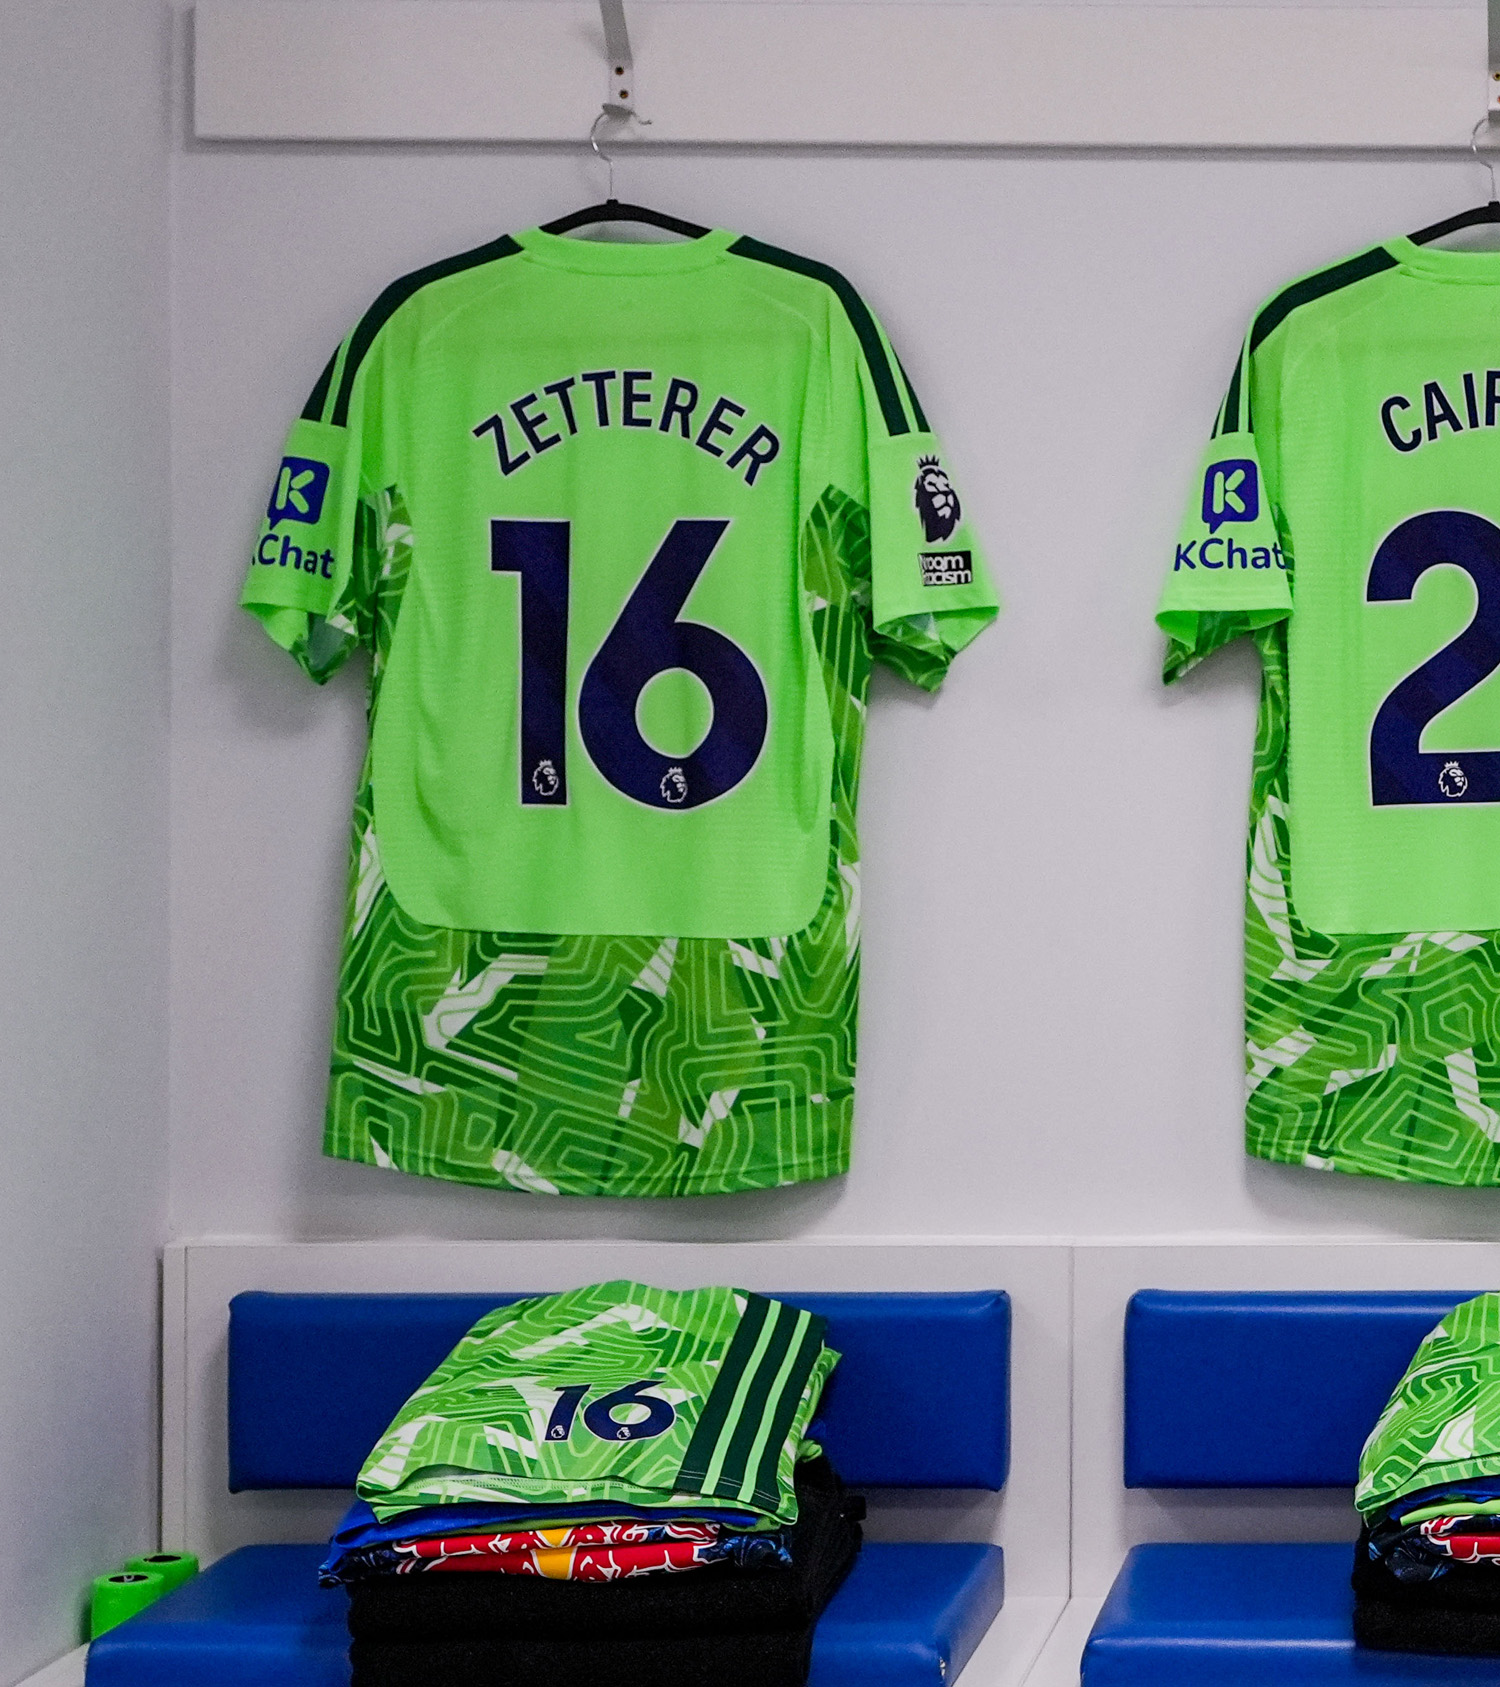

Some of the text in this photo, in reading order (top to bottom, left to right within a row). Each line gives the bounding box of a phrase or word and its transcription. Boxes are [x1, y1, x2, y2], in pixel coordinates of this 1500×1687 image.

[472, 370, 780, 487] ZETTERER
[275, 466, 315, 514] K
[1212, 469, 1246, 515] K
[251, 533, 335, 579] Chat
[1173, 537, 1287, 571] KChat
[490, 519, 768, 811] 16
[544, 1379, 677, 1441] 16
